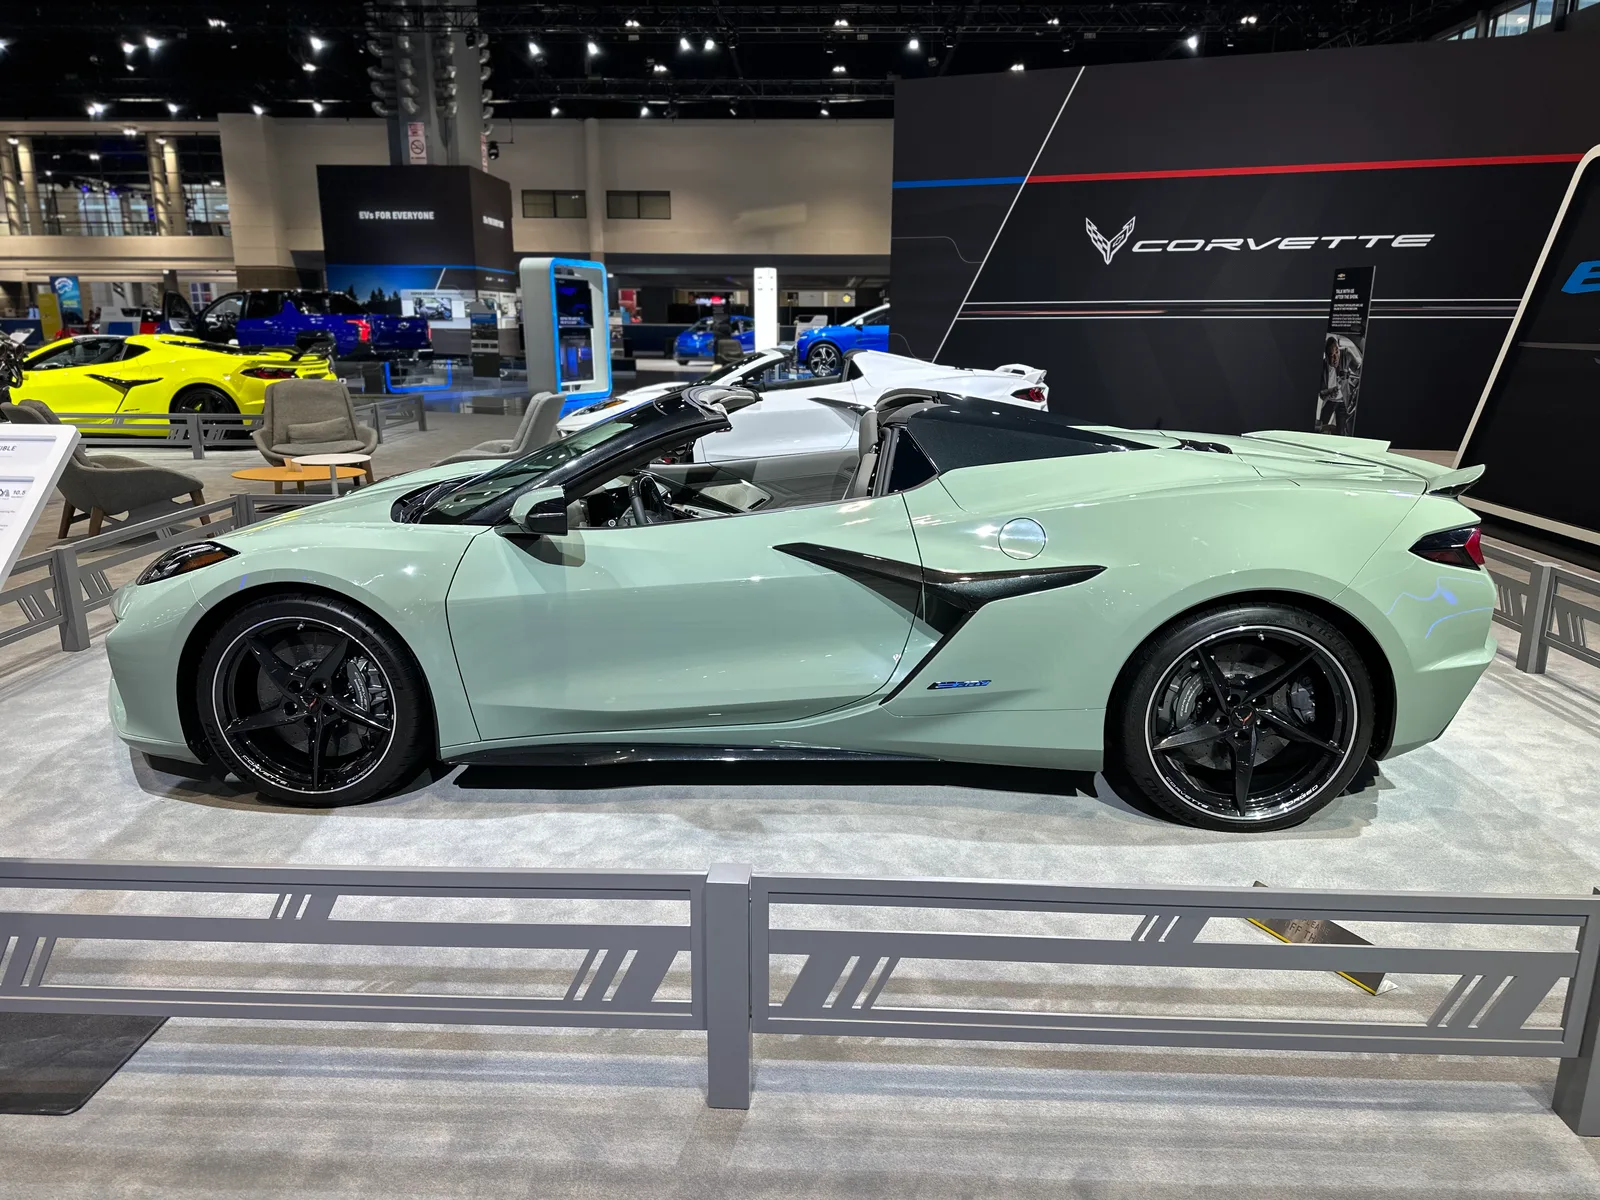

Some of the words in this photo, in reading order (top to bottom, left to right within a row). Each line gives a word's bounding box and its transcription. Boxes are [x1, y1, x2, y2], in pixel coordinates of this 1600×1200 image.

[358, 211, 374, 220] EVs
[375, 211, 391, 220] FOR
[392, 211, 435, 220] EVERYONE
[1131, 233, 1435, 253] CORVETTE
[242, 754, 288, 785] CORVETTE
[1165, 776, 1209, 809] CORVETTE
